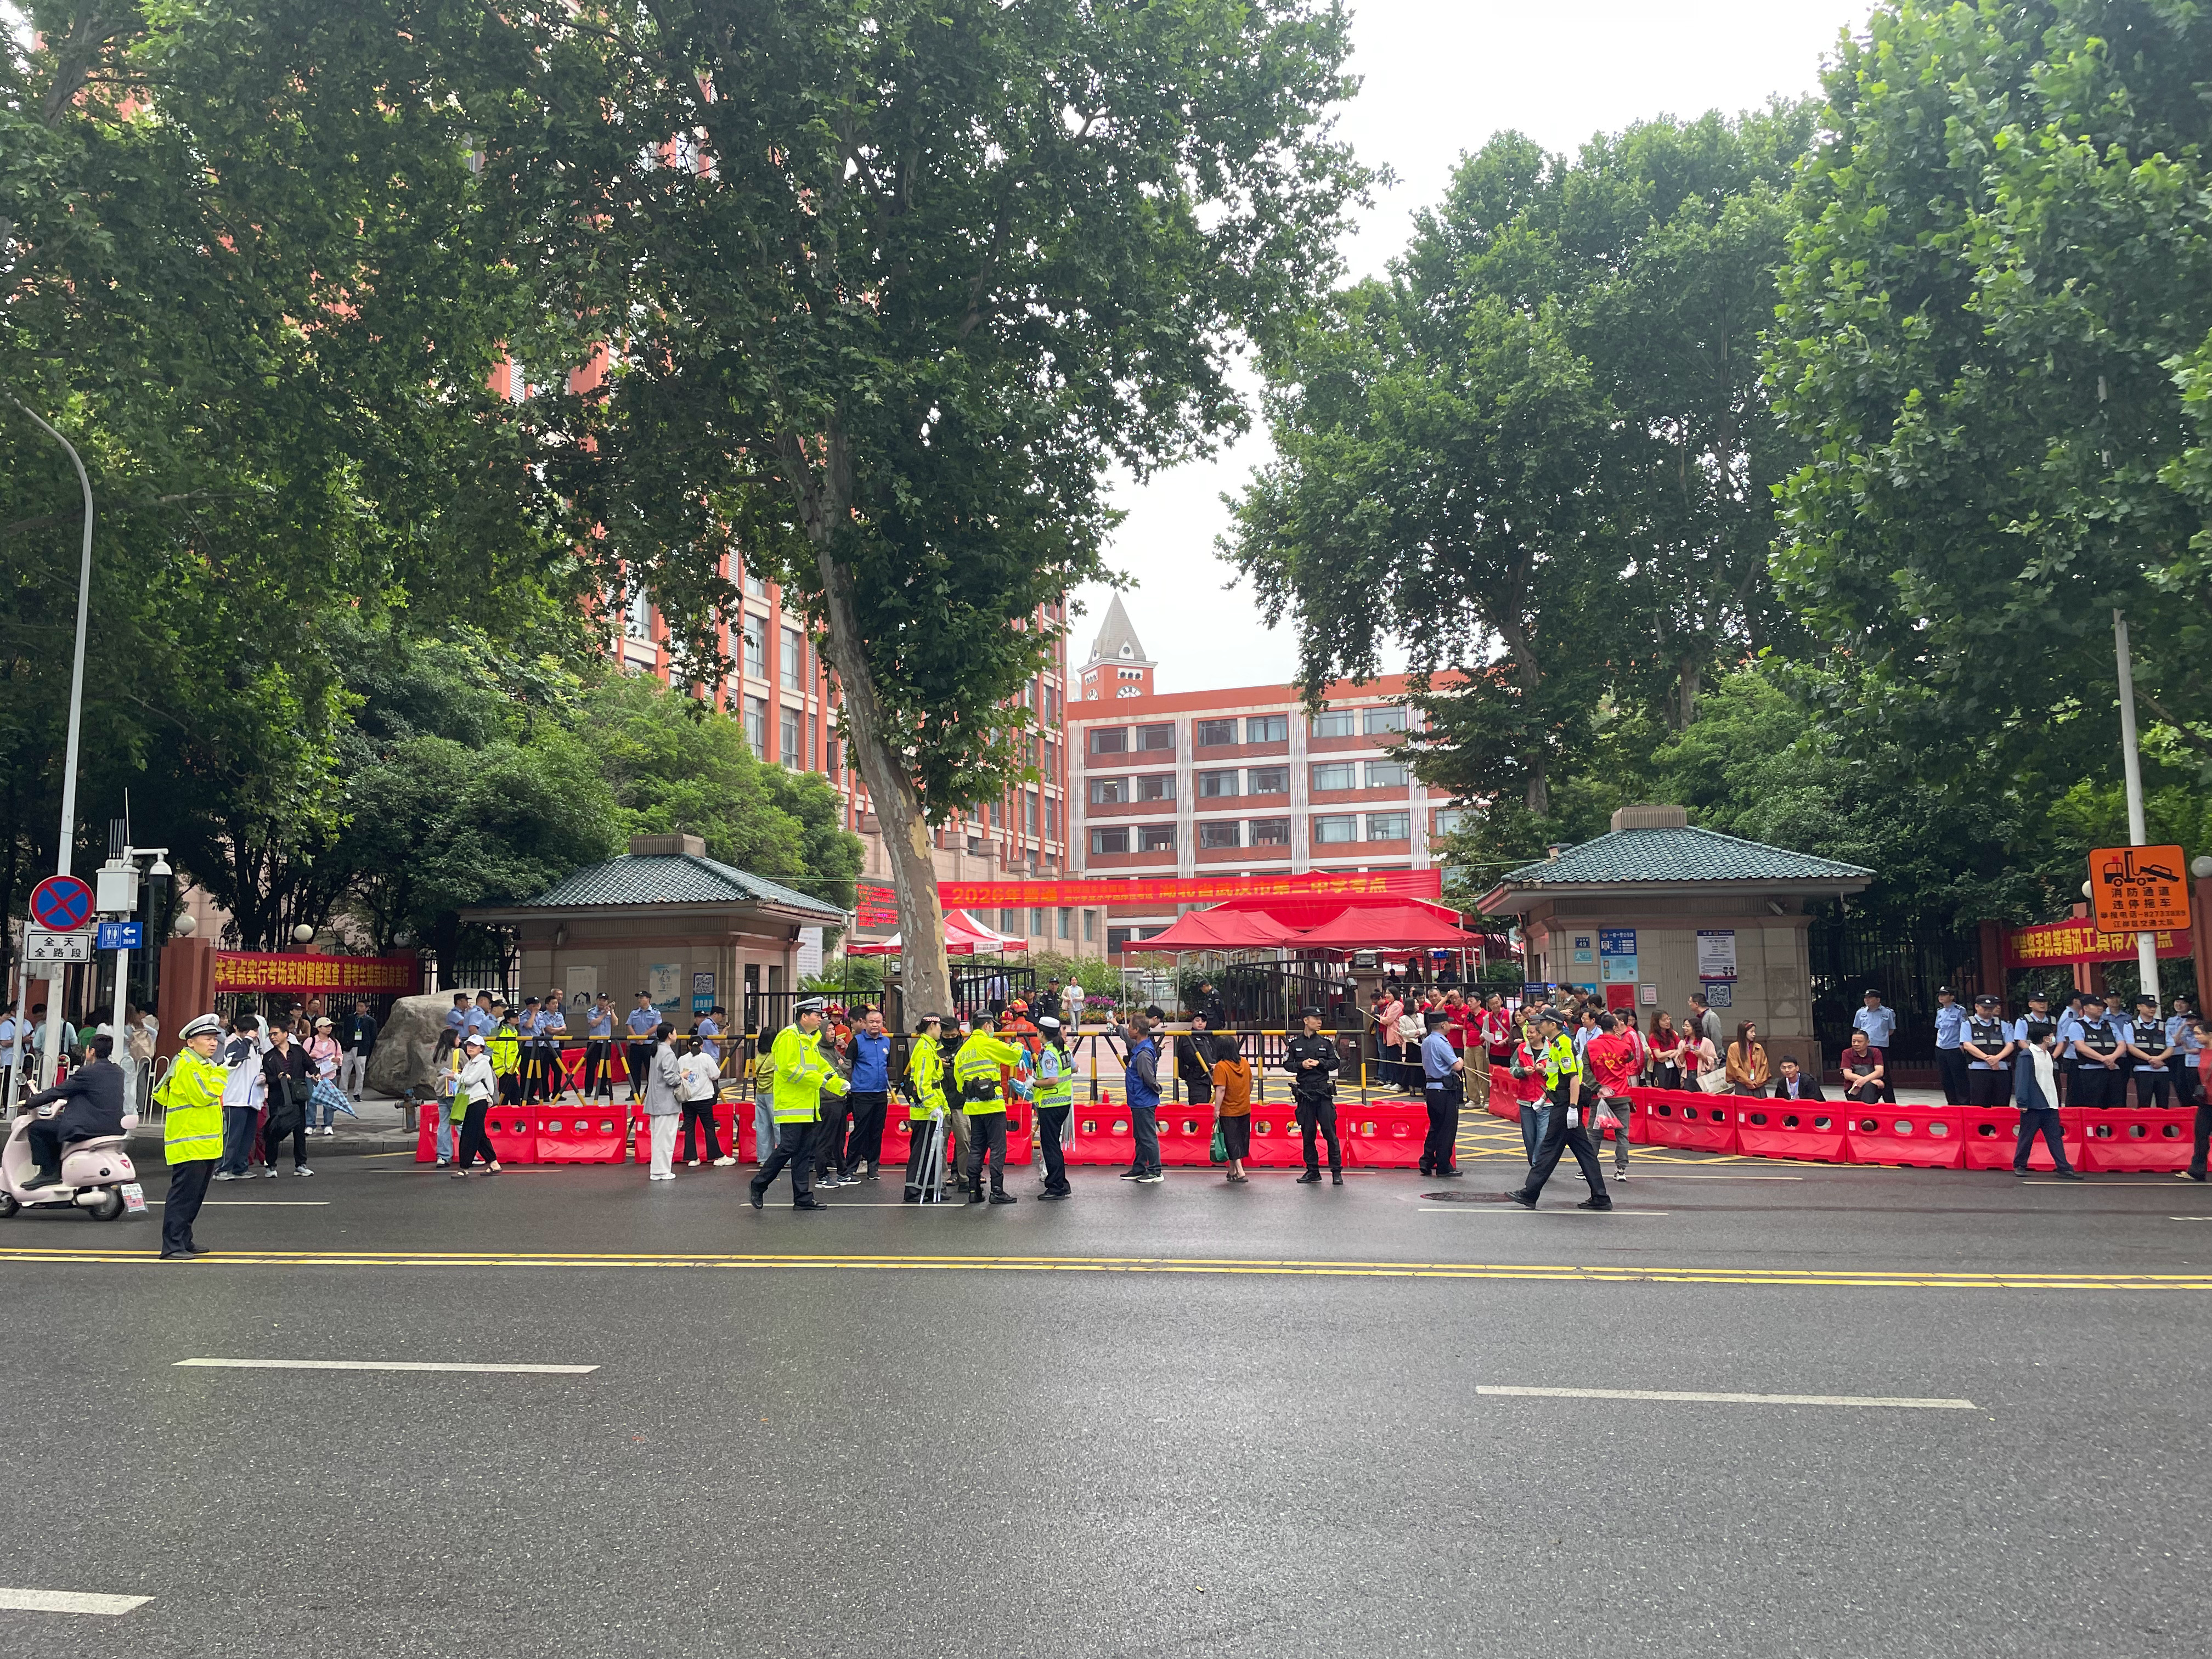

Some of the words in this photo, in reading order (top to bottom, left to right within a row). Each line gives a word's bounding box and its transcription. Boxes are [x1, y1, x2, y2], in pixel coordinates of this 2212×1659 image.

[1159, 877, 1387, 899] 湖北省武汉市第二中学考点
[2112, 886, 2170, 898] 消防通道
[952, 887, 1057, 904] 2026年普通
[2113, 898, 2171, 910] 违停拖车
[2113, 918, 2175, 928] 江岸区交通大队
[44, 936, 74, 947] 全天
[2011, 927, 2174, 960] 严禁将手机等通讯工具带入点
[35, 947, 82, 958] 全路段
[215, 958, 340, 986] 本考点实行考场实时智能巡查
